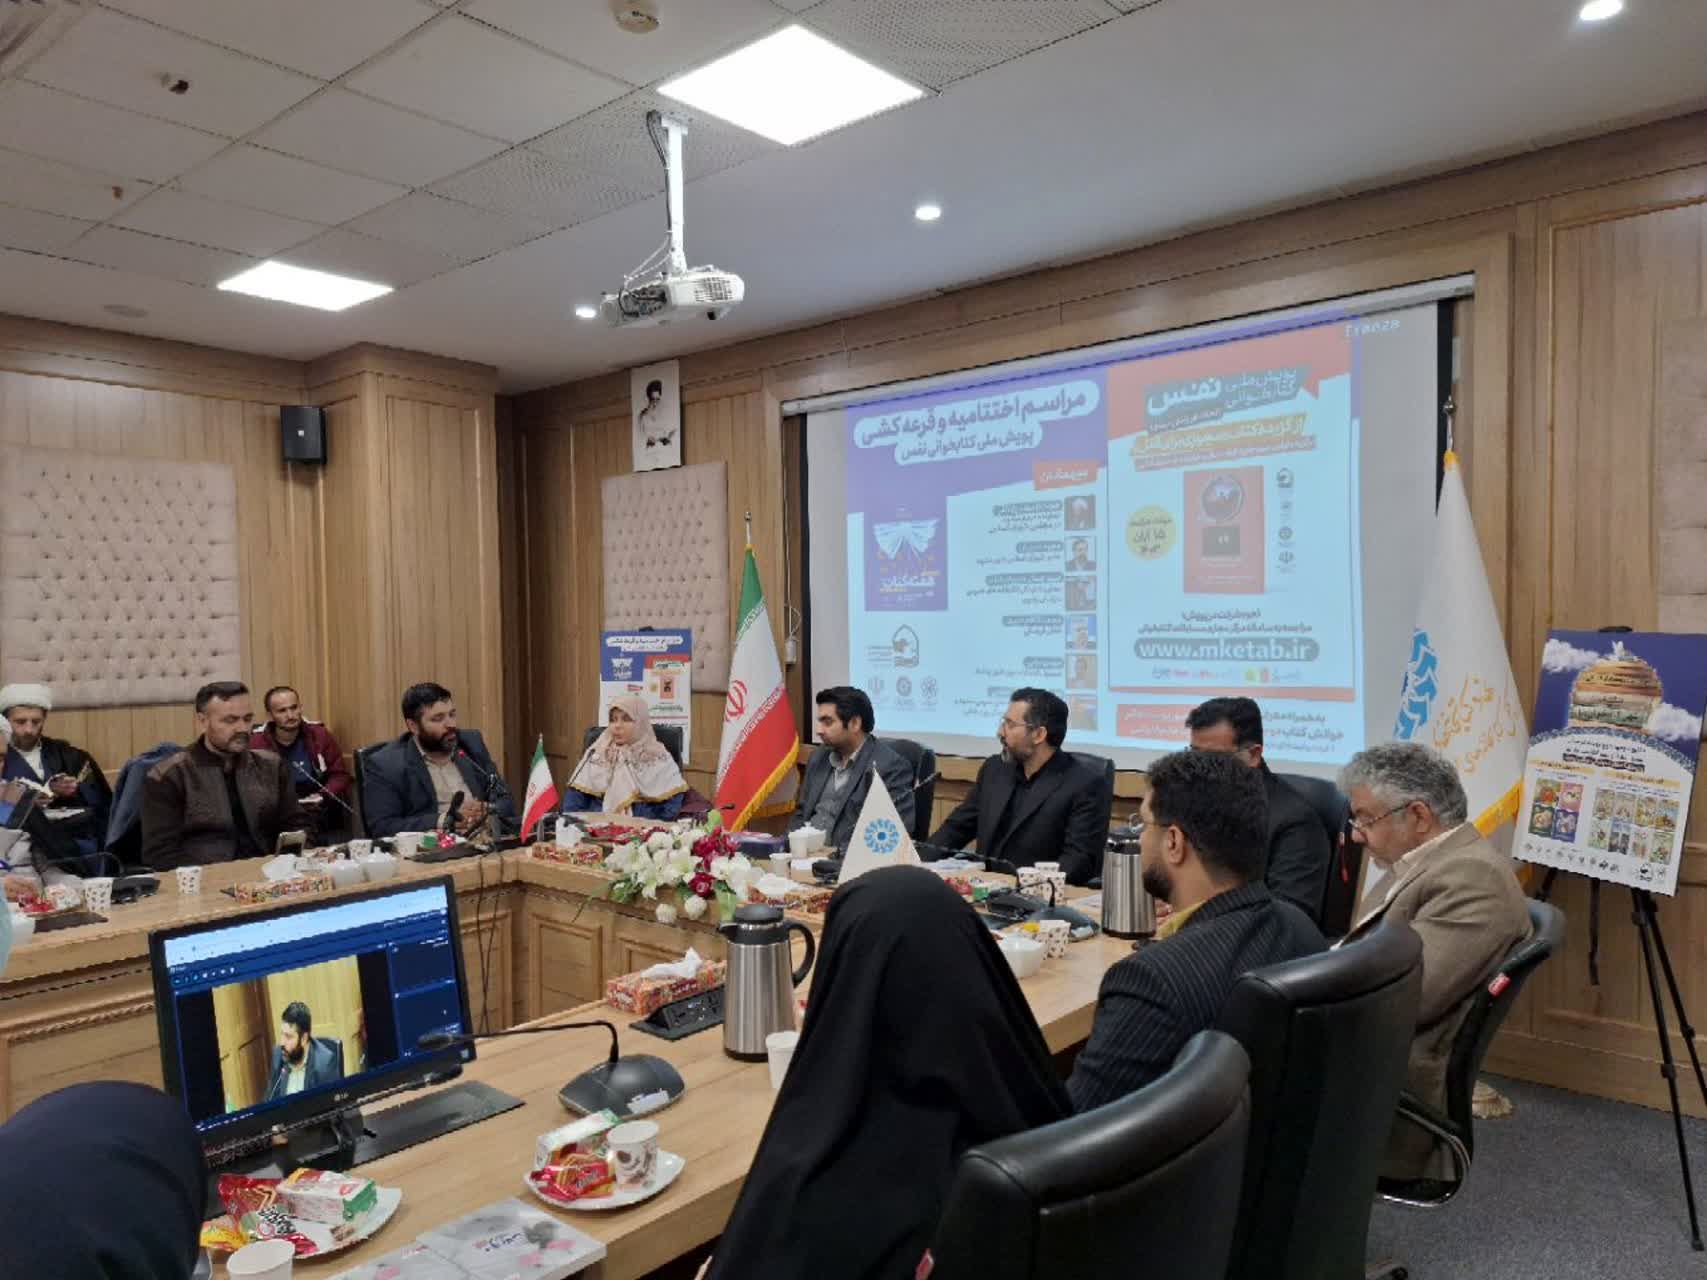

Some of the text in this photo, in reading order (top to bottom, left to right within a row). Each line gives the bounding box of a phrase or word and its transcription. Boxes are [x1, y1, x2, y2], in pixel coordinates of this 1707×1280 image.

[1147, 376, 1222, 415] نفس
[862, 388, 1086, 445] مراسم اختتامیه و قرعه کشی
[1138, 637, 1310, 659] www.mketab.ir
